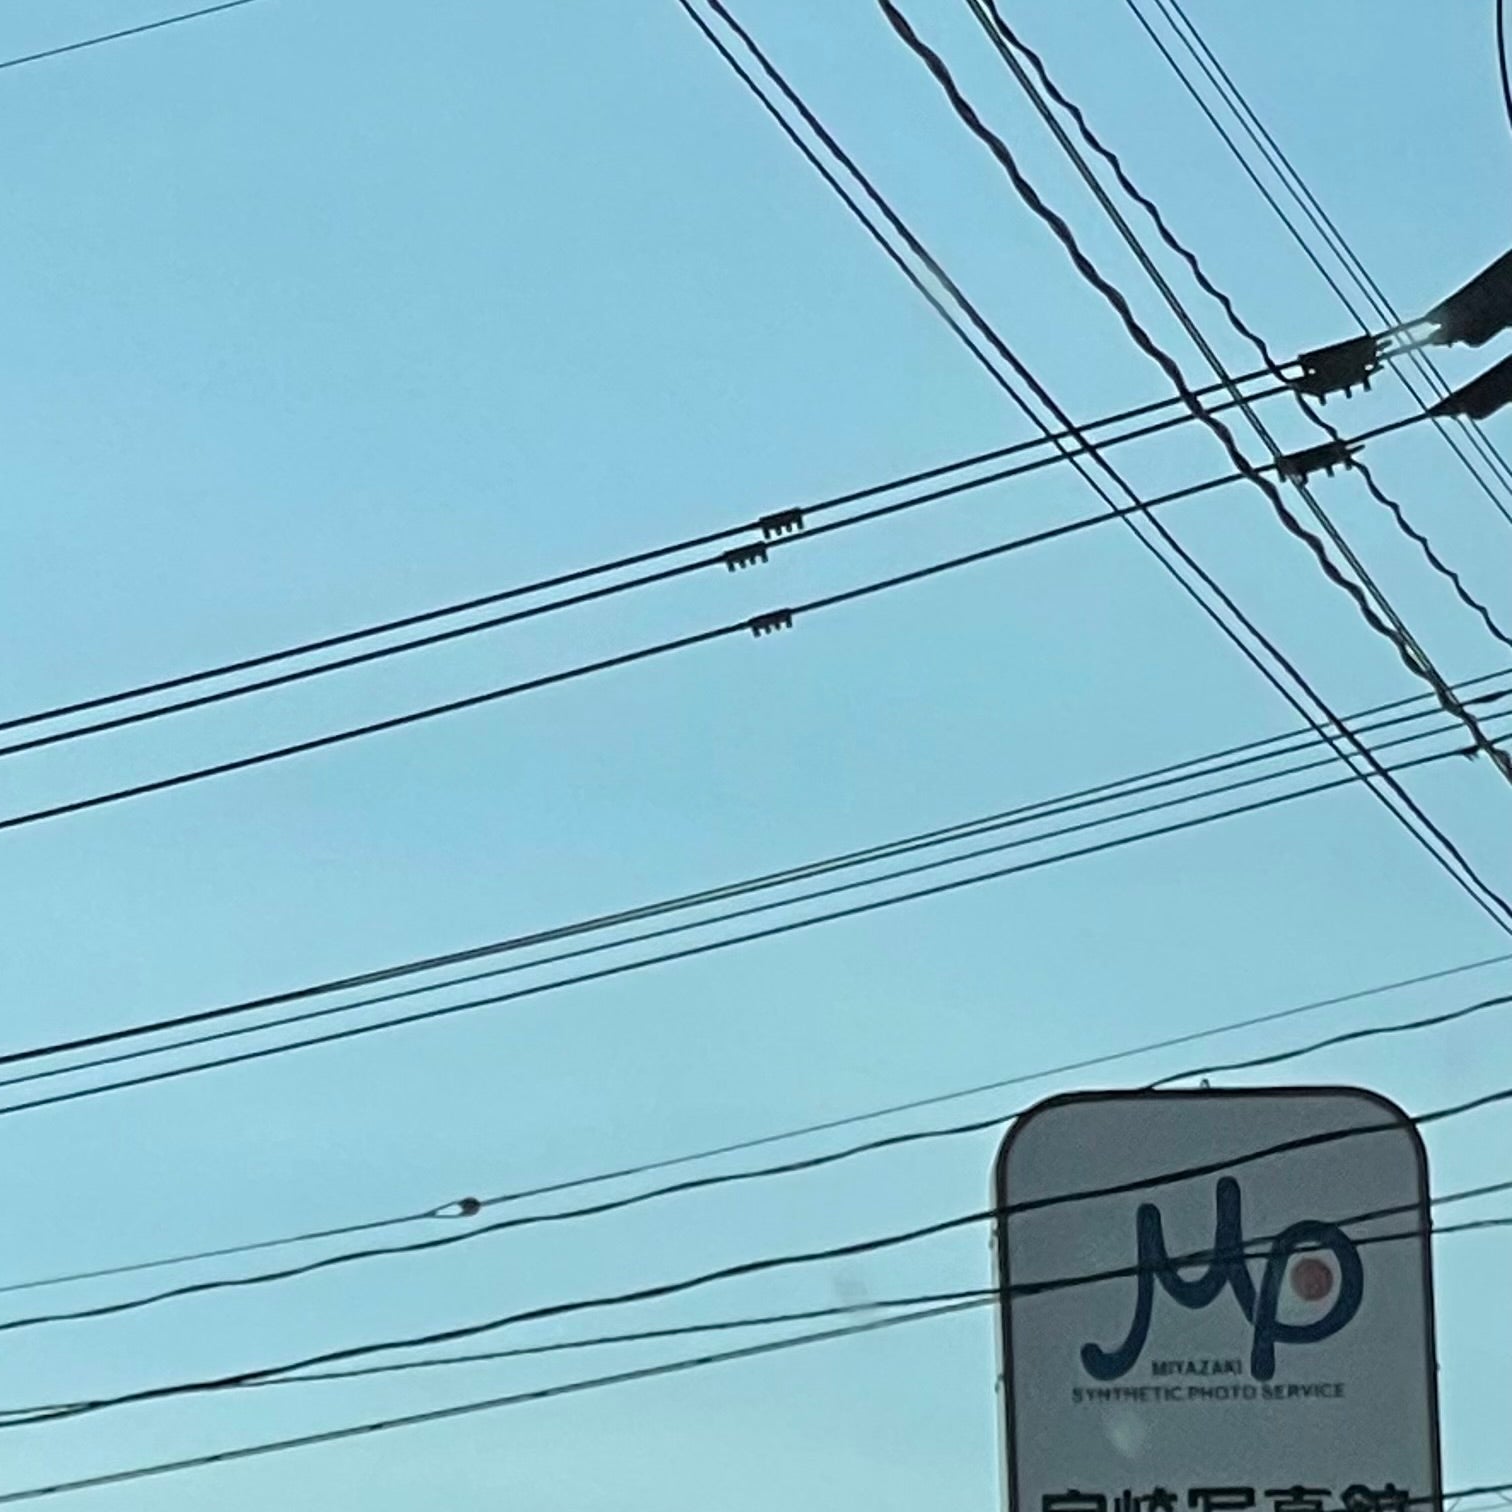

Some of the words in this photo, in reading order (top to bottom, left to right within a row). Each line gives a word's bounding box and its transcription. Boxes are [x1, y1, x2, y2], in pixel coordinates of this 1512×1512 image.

[1151, 1359, 1243, 1377] MIYAZAKI
[1072, 1386, 1185, 1404] SYNTHETIC
[1188, 1384, 1256, 1401] PHOTO
[1261, 1382, 1346, 1400] SERVICE
